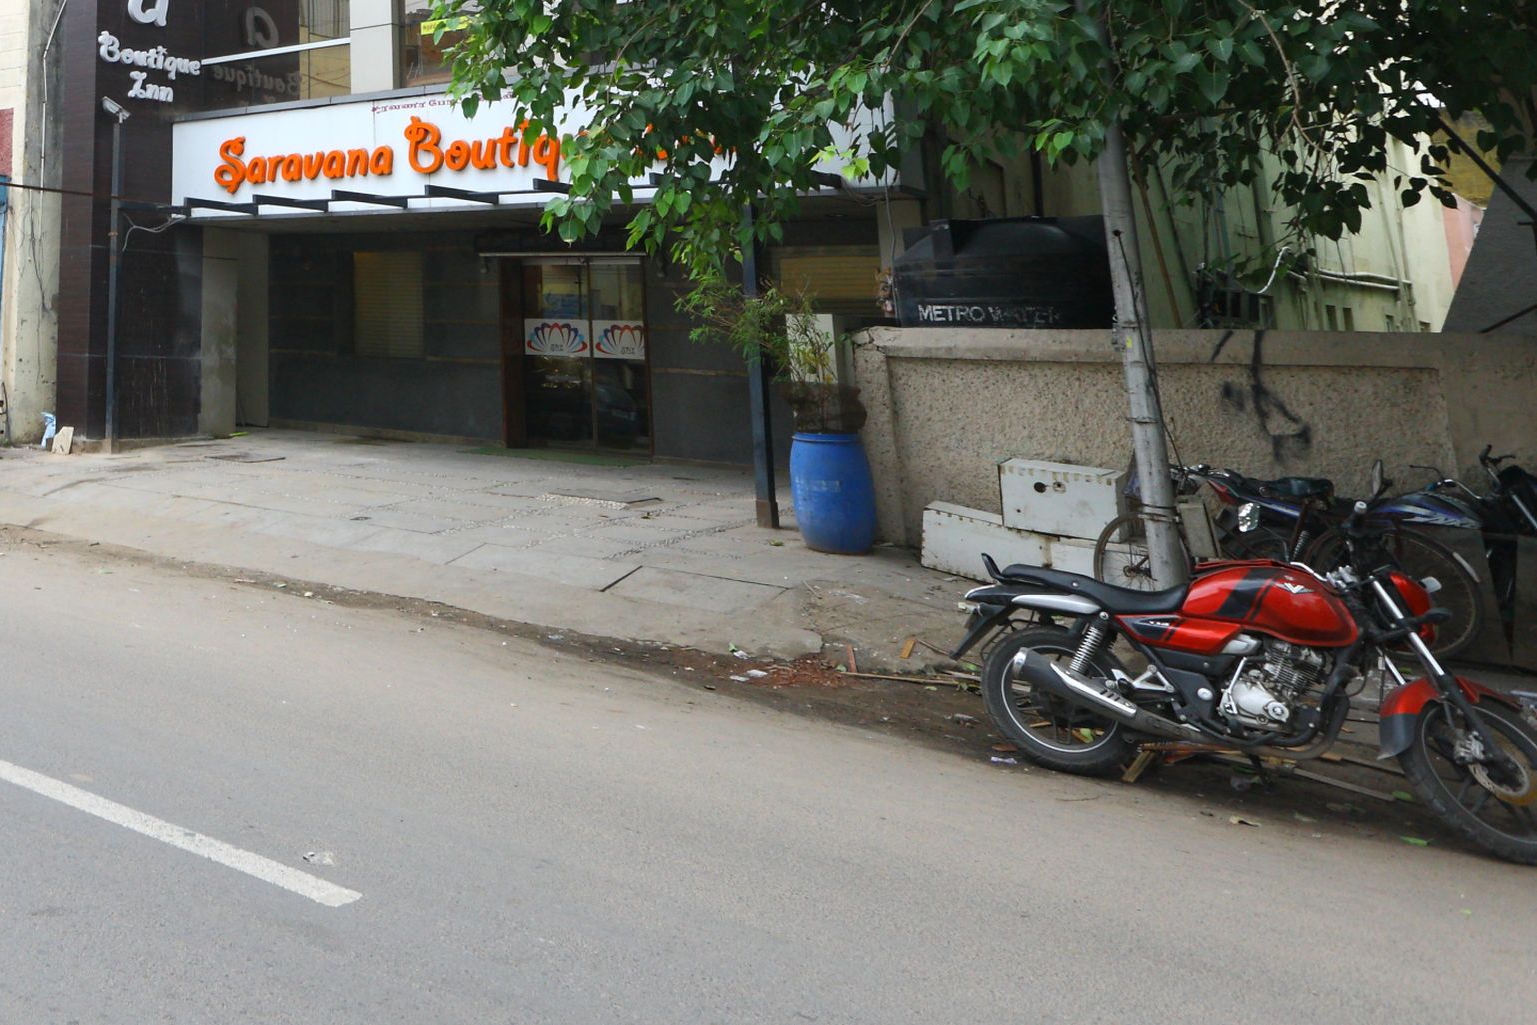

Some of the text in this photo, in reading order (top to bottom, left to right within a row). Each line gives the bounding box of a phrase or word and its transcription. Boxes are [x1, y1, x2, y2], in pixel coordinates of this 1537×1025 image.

[98, 30, 201, 80] Boutique
[128, 70, 174, 102] Inn
[214, 137, 394, 194] Saravana
[404, 115, 563, 183] Boutiq
[918, 304, 985, 322] METRO
